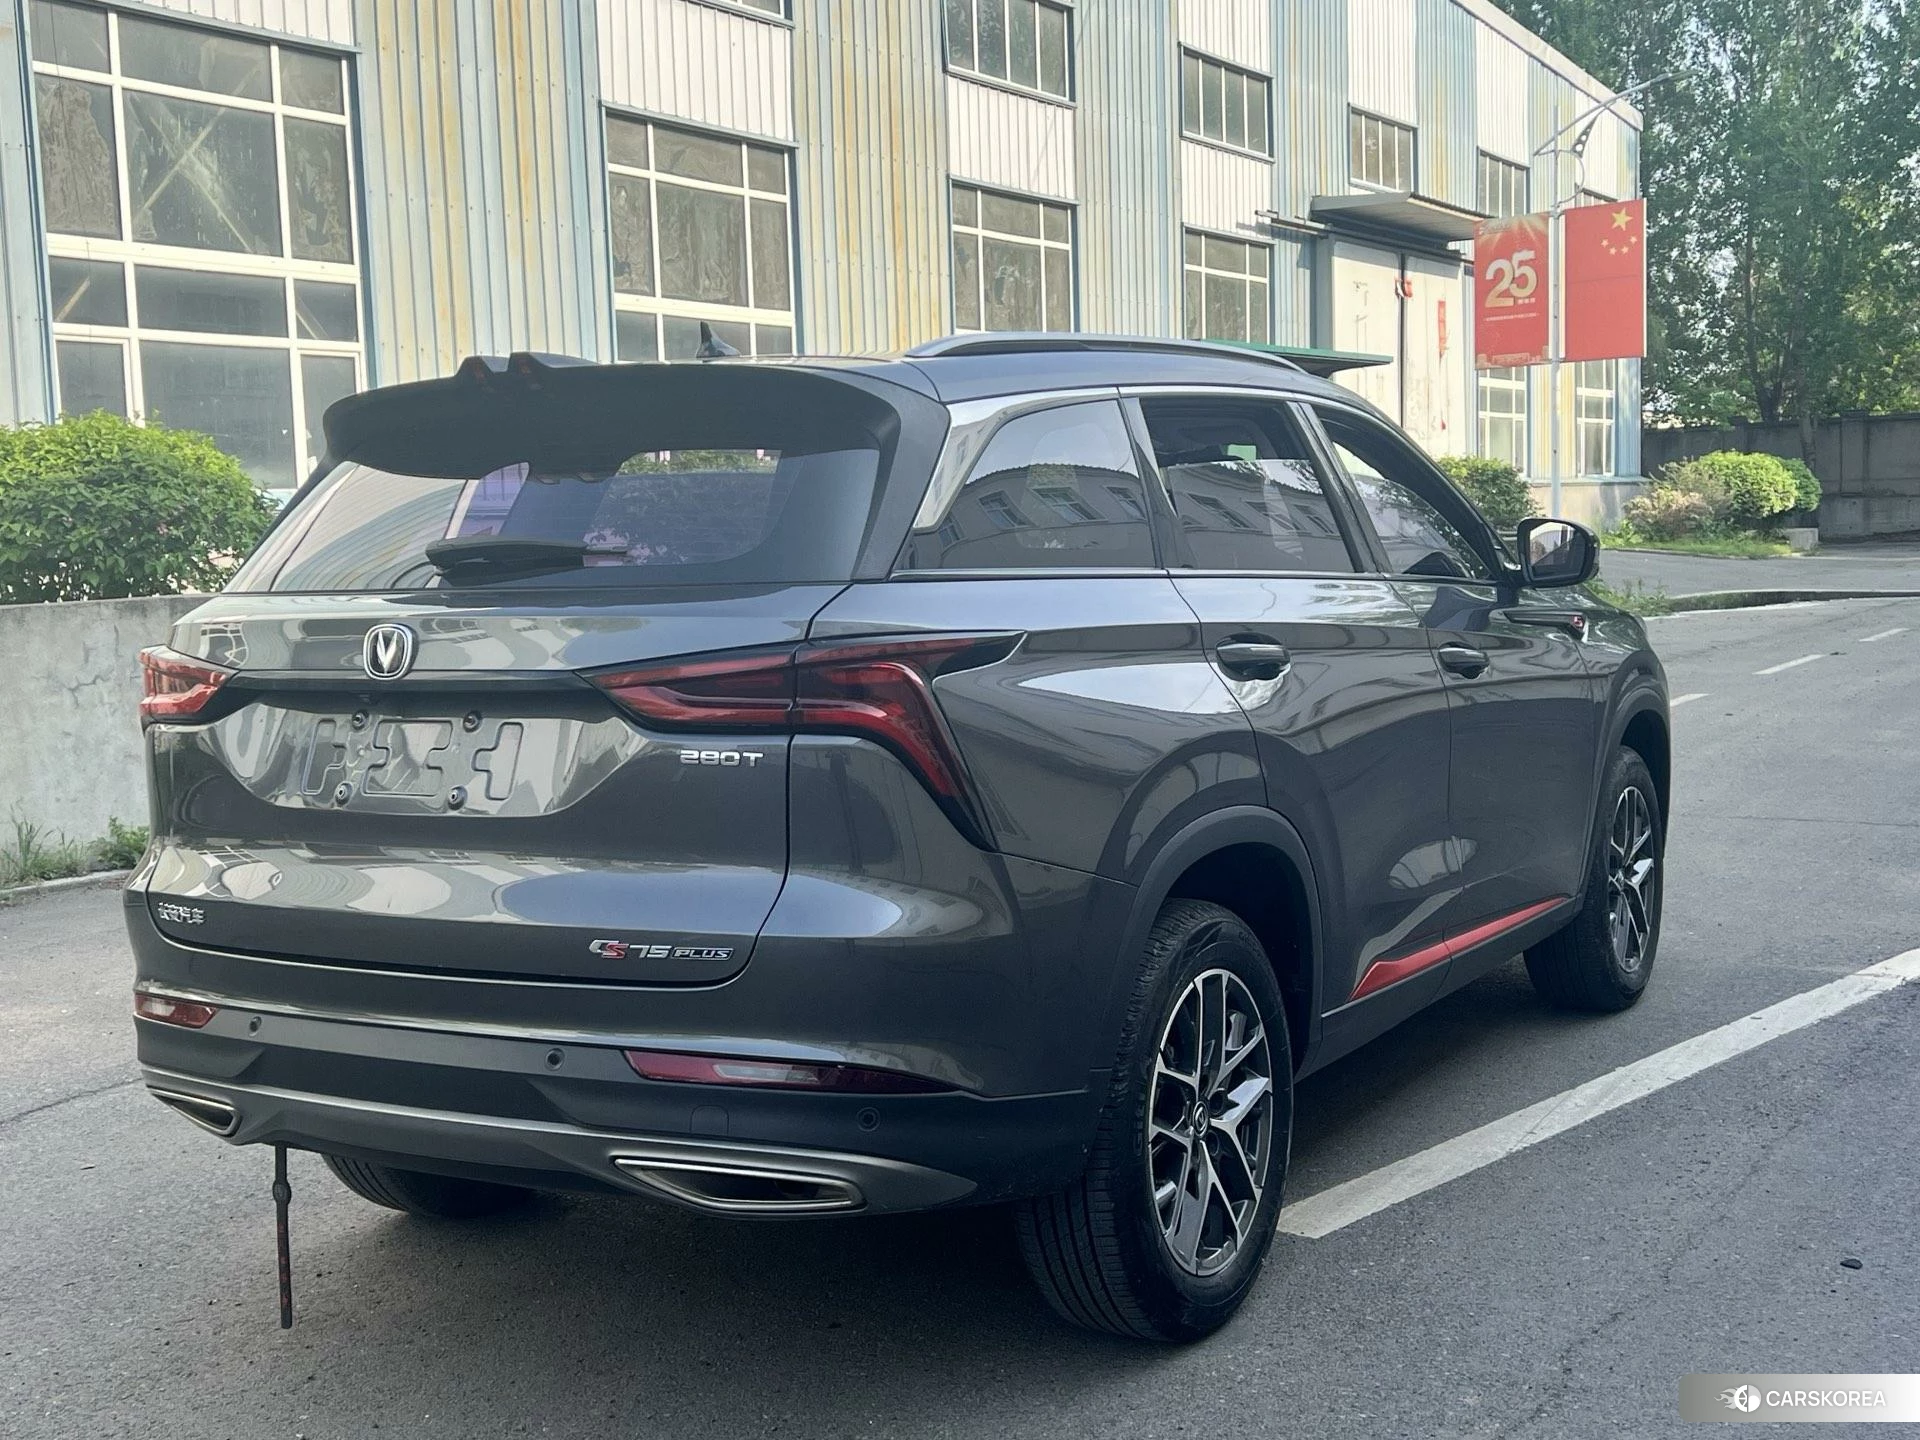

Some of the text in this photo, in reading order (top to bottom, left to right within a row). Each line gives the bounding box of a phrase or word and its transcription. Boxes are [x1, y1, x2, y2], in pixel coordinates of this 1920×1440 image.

[1484, 249, 1538, 308] 25
[680, 749, 764, 767] 280T
[673, 948, 731, 959] PLUS
